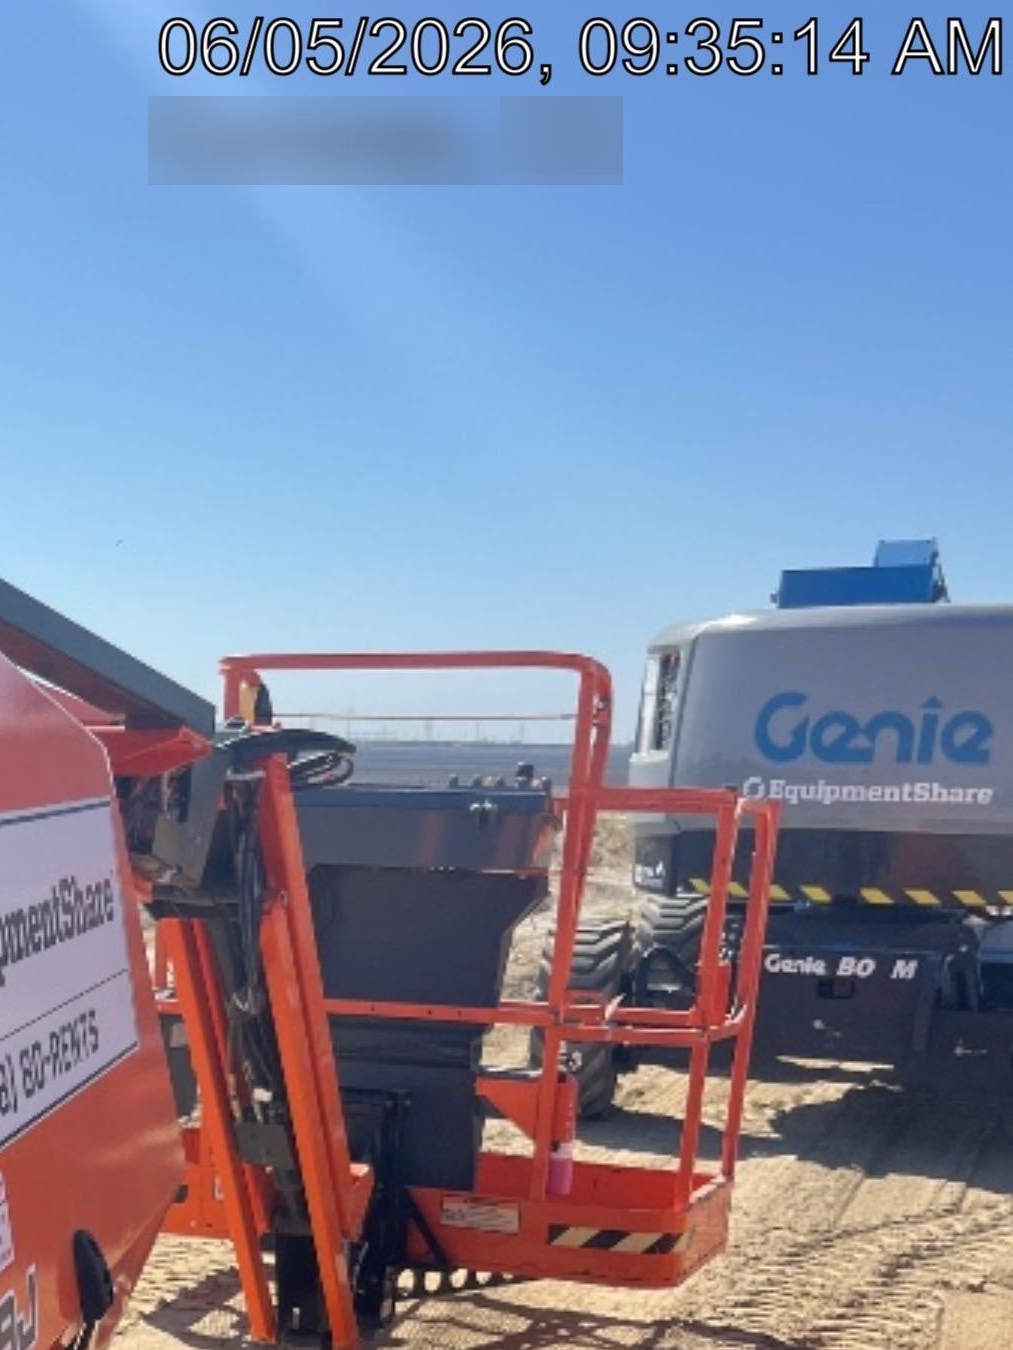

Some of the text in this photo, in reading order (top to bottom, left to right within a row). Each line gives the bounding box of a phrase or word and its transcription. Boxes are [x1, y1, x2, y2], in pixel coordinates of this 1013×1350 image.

[755, 691, 993, 766] Genie
[768, 779, 993, 806] EquipmentShare
[764, 953, 827, 976] Genie
